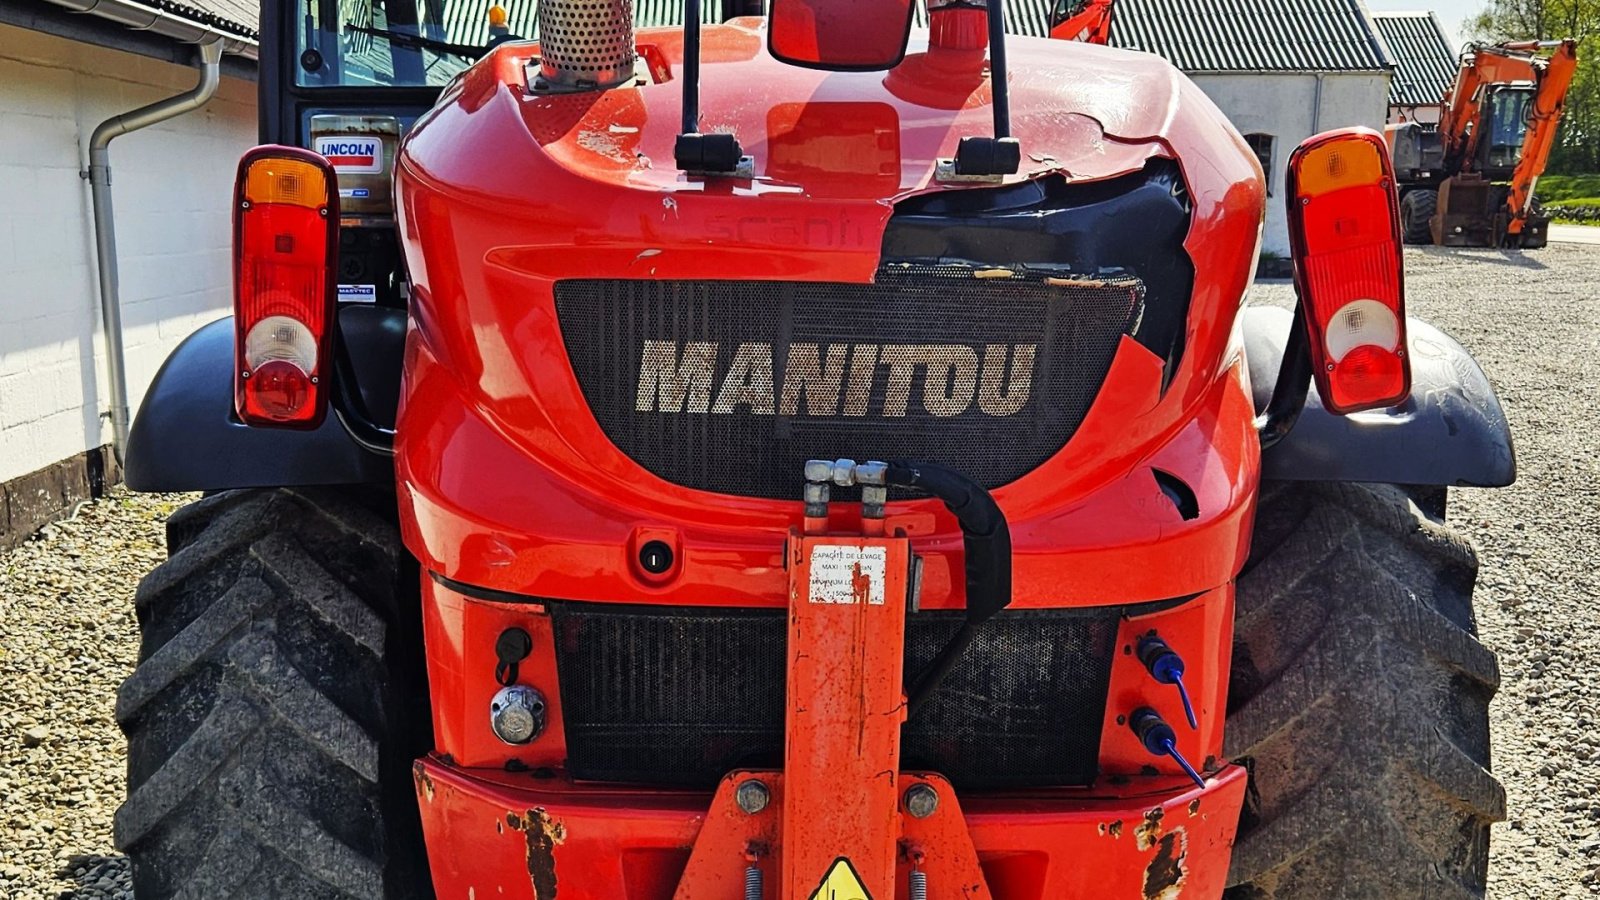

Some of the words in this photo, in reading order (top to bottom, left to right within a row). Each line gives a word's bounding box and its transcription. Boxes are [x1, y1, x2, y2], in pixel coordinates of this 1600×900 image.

[321, 143, 375, 156] LINCOLN
[634, 339, 1038, 418] MANITOU
[845, 552, 856, 560] DE
